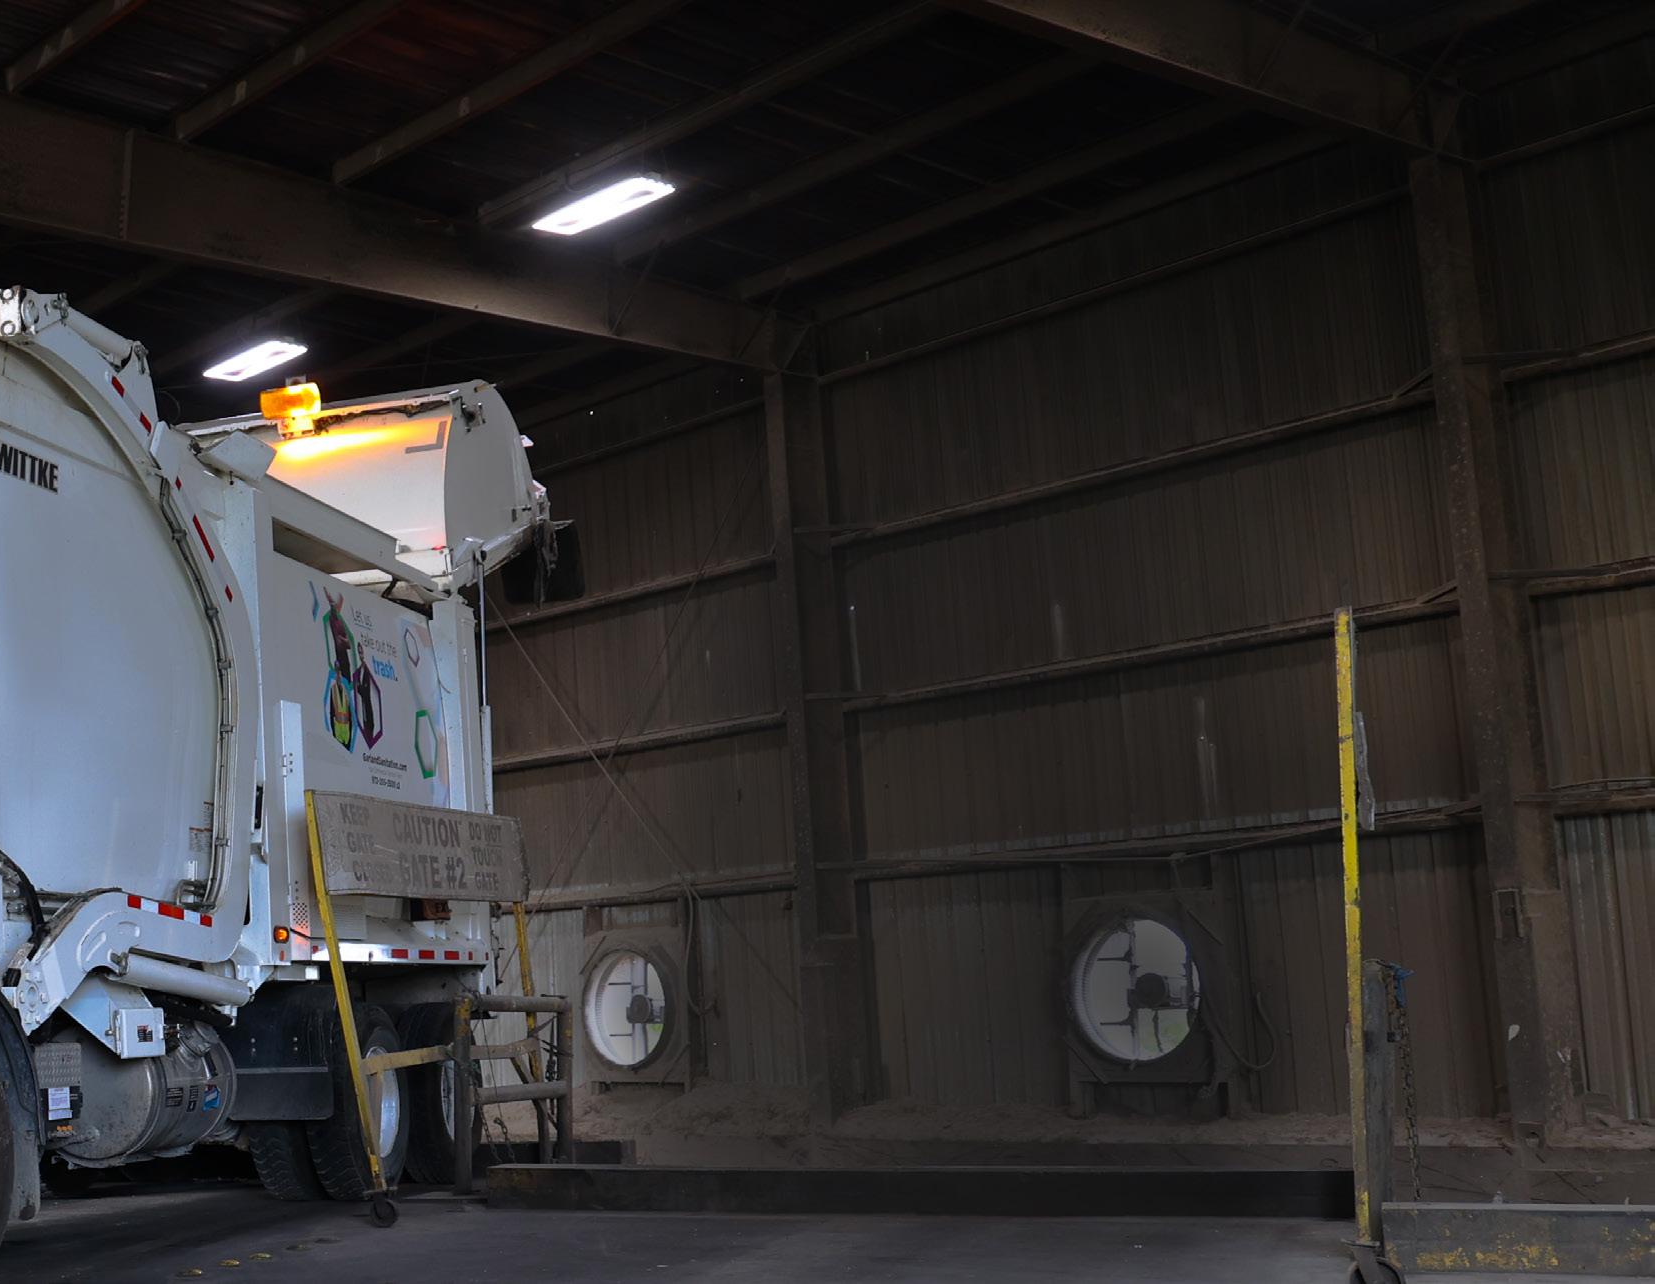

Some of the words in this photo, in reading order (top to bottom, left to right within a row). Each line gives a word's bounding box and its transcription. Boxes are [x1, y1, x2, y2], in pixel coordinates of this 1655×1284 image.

[371, 655, 399, 682] trash.
[339, 802, 371, 826] KEEP
[392, 812, 461, 848] CAUTION
[468, 821, 482, 841] DO
[484, 823, 502, 843] NOT
[346, 831, 375, 855] GATE
[399, 851, 442, 889] GATE
[444, 856, 468, 889] #2
[474, 871, 500, 891] GATE
